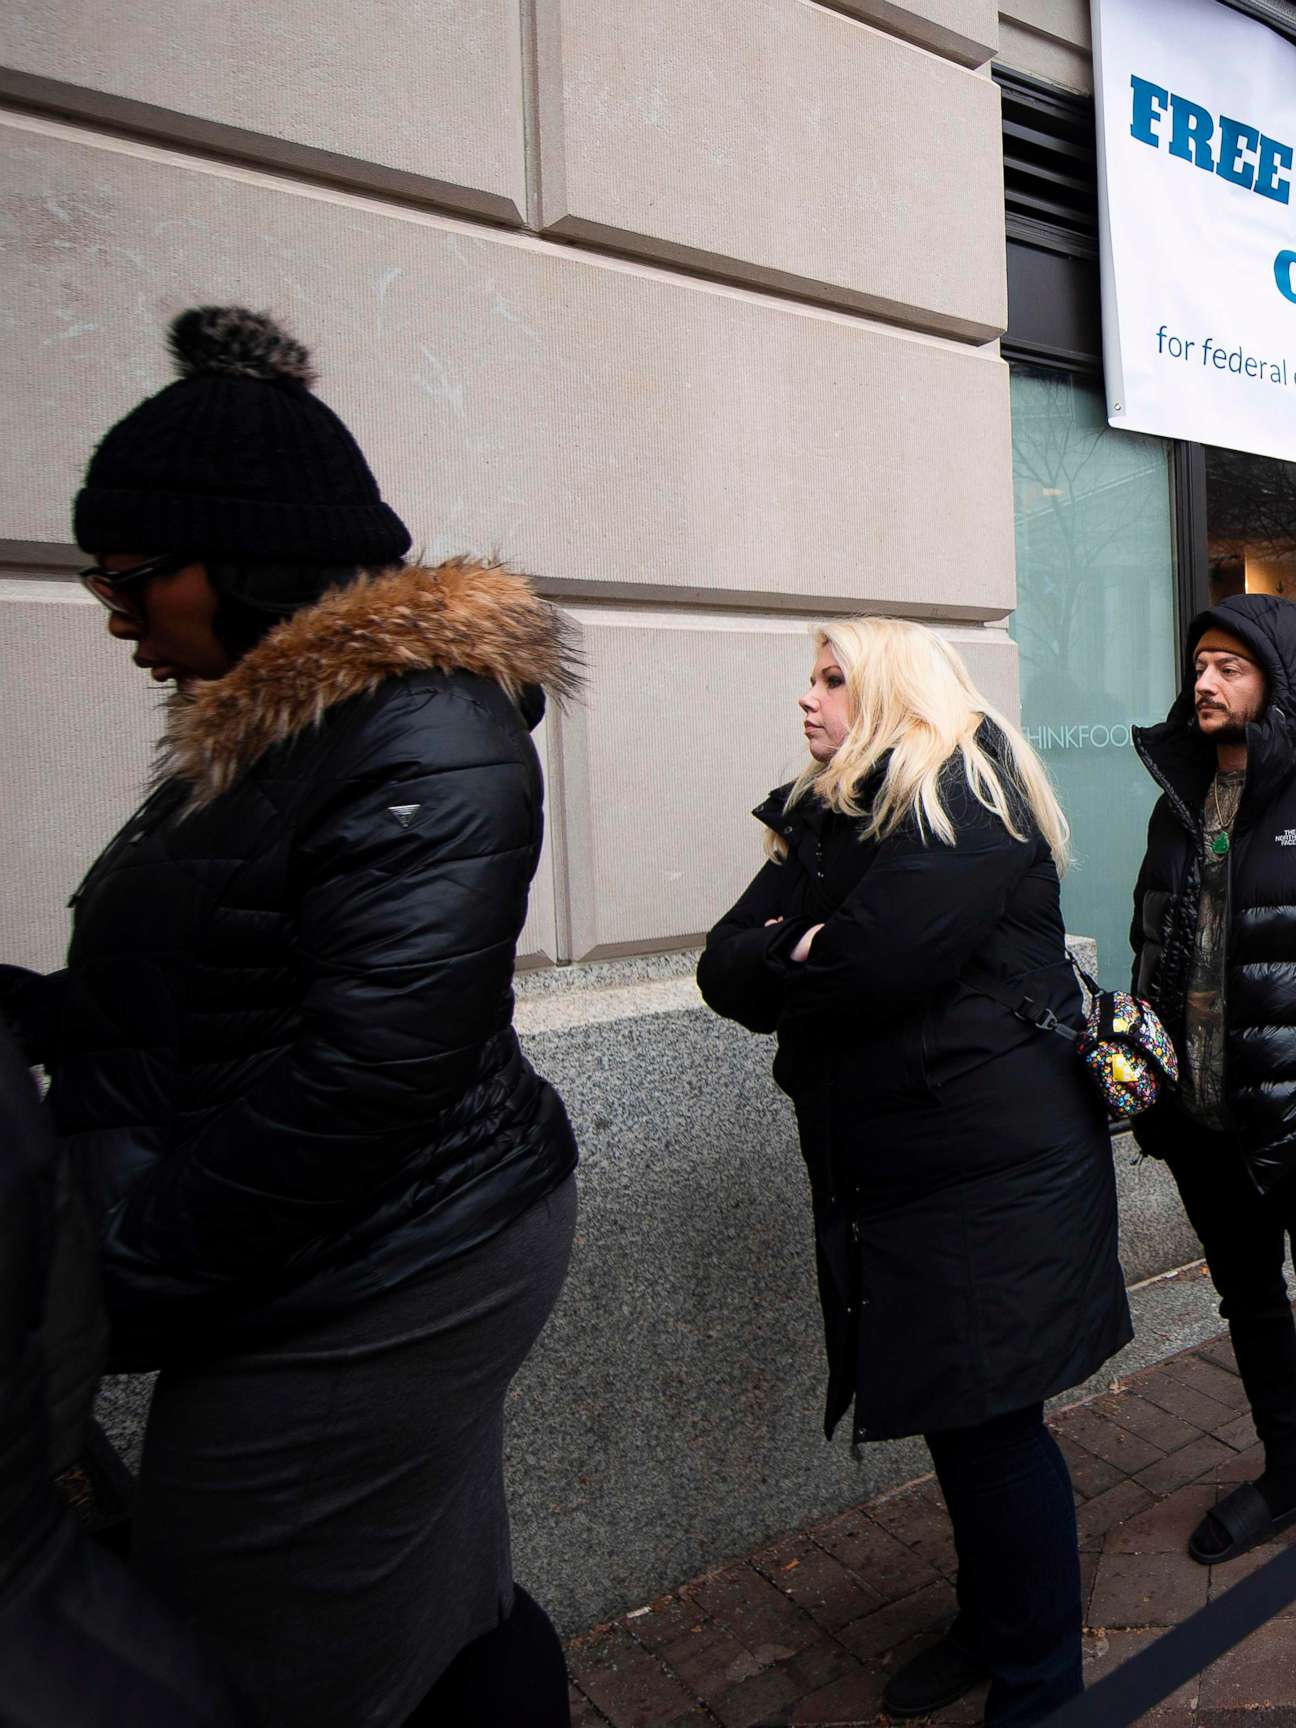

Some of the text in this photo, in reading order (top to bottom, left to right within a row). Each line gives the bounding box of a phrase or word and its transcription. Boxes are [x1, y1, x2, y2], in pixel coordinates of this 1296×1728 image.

[1130, 74, 1294, 205] FREE
[1156, 325, 1195, 361] for
[1202, 338, 1288, 386] federal
